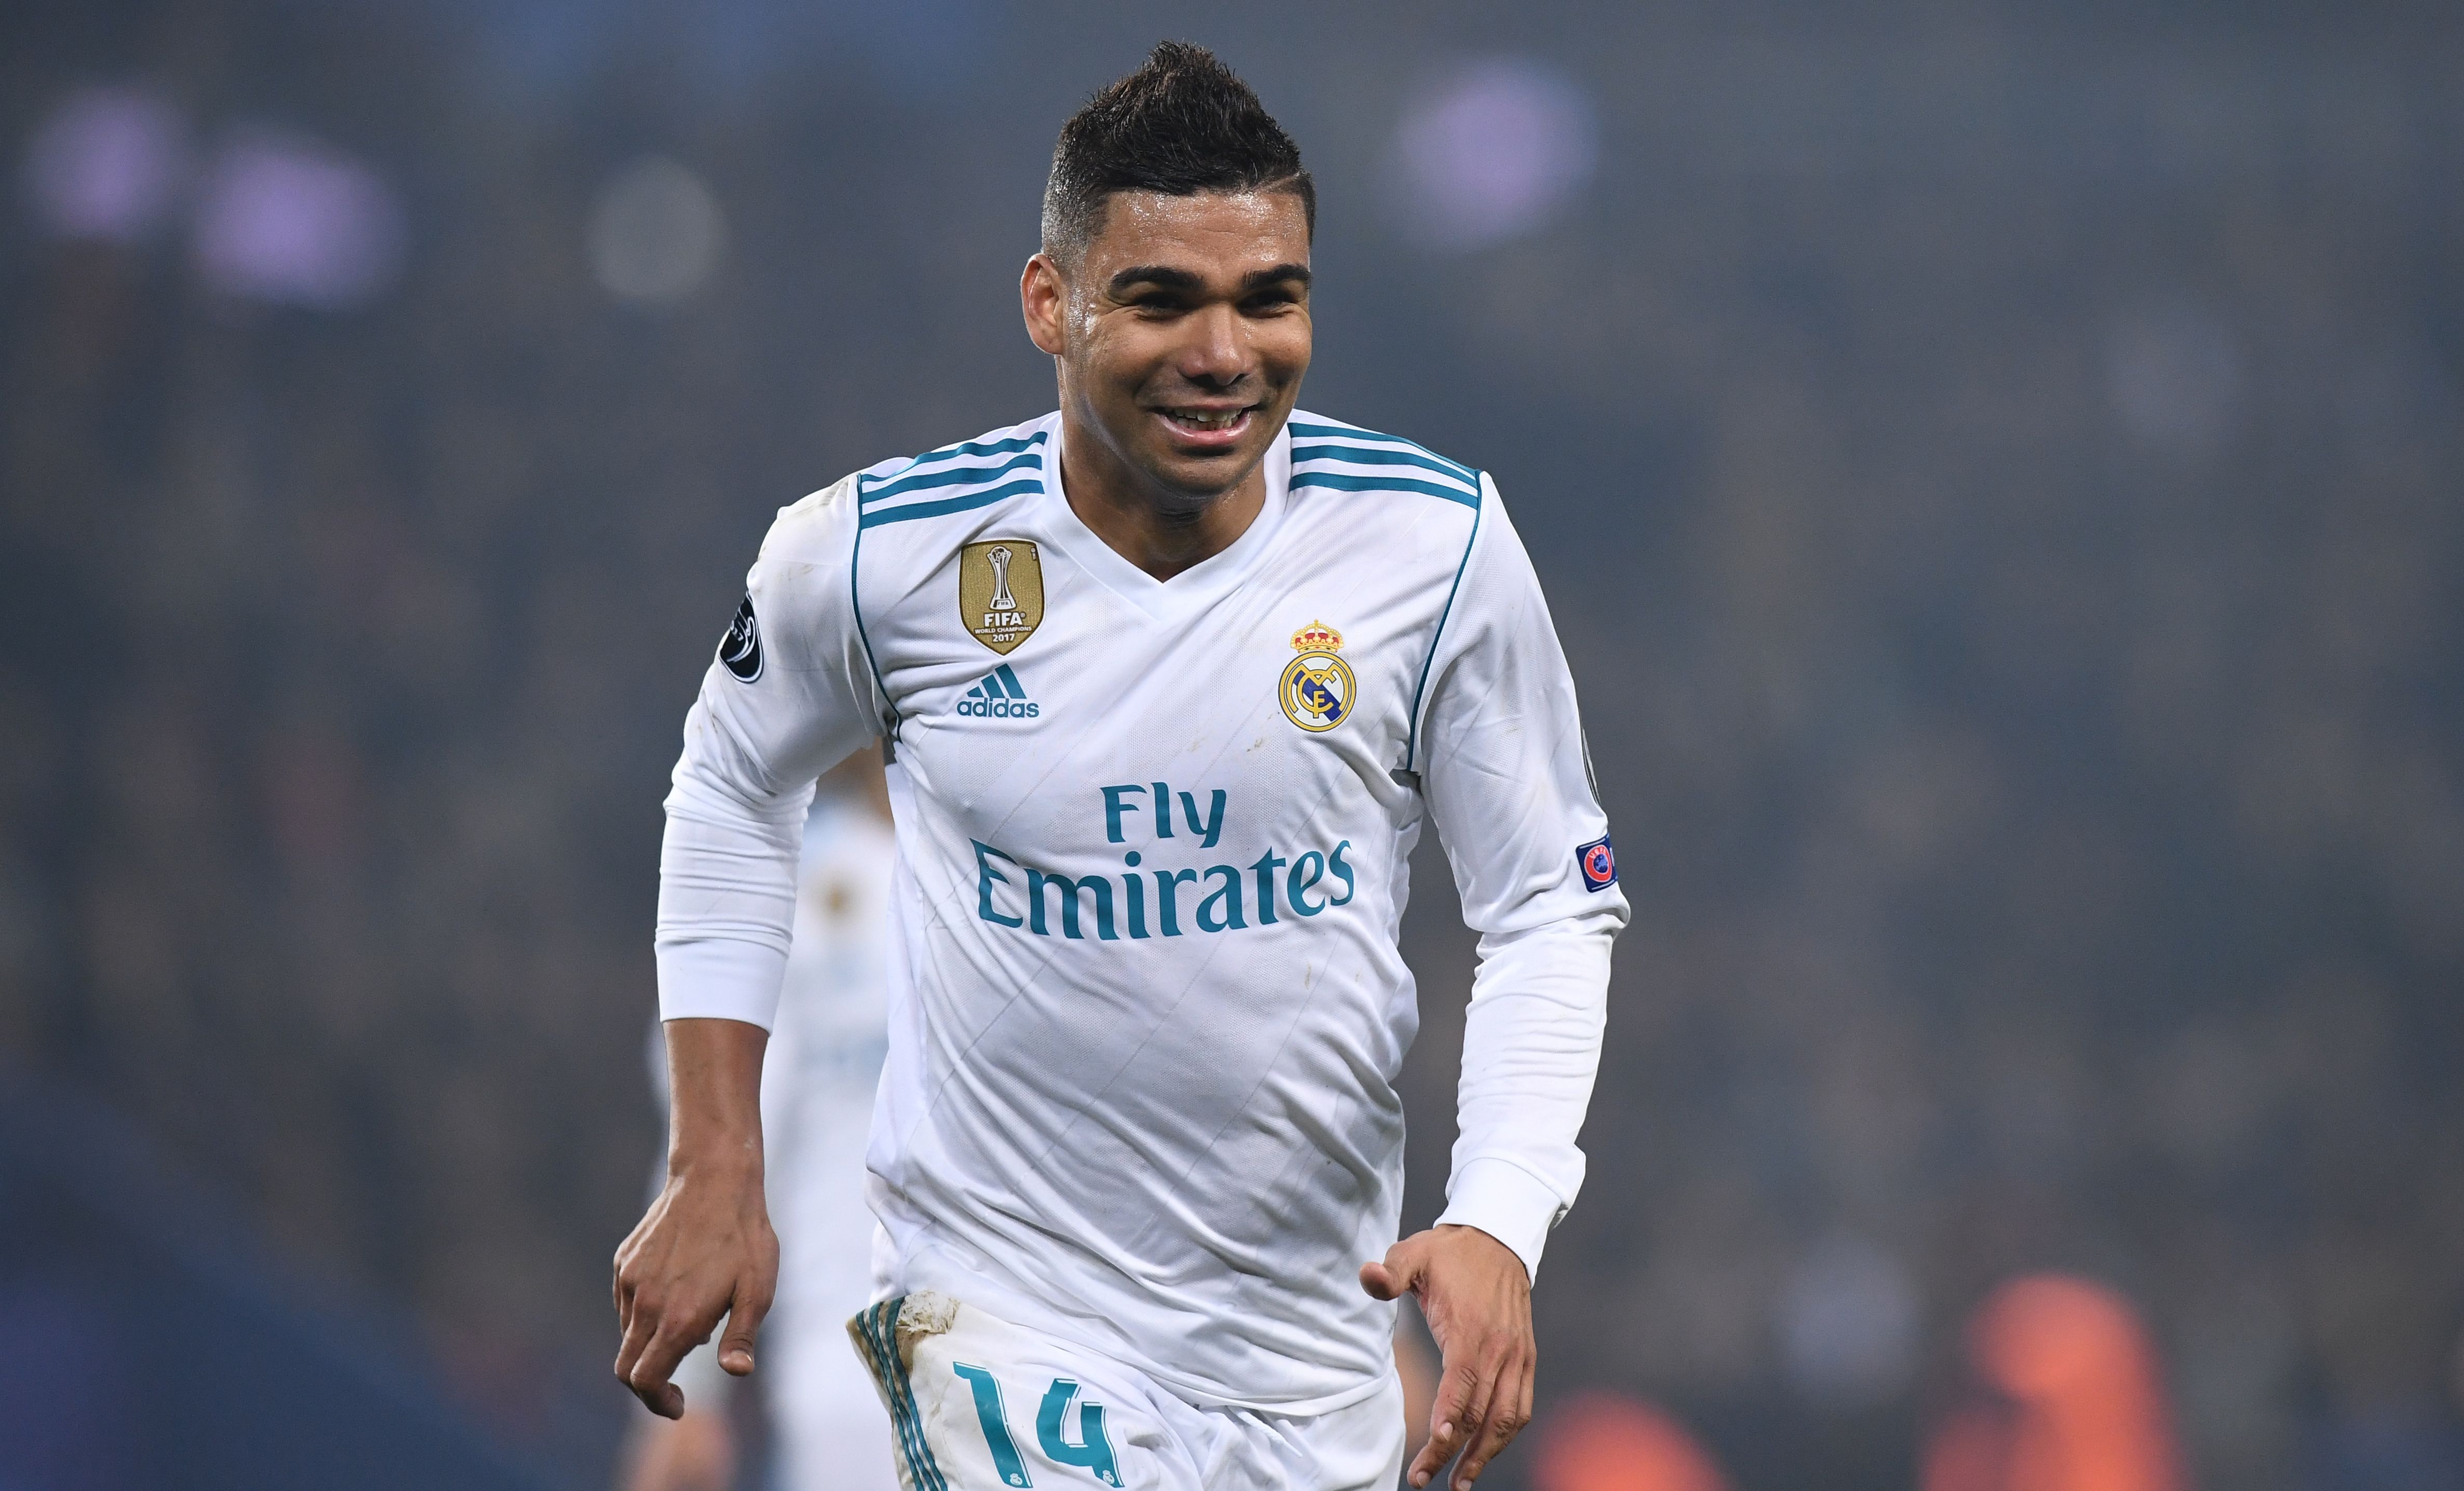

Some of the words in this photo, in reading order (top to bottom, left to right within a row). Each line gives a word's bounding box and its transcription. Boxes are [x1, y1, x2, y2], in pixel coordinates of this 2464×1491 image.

[992, 633, 1015, 642] 2017
[957, 697, 1040, 718] adidas
[1099, 782, 1227, 848] Fly
[969, 838, 1353, 941] Emirates
[953, 1361, 1125, 1488] 14
